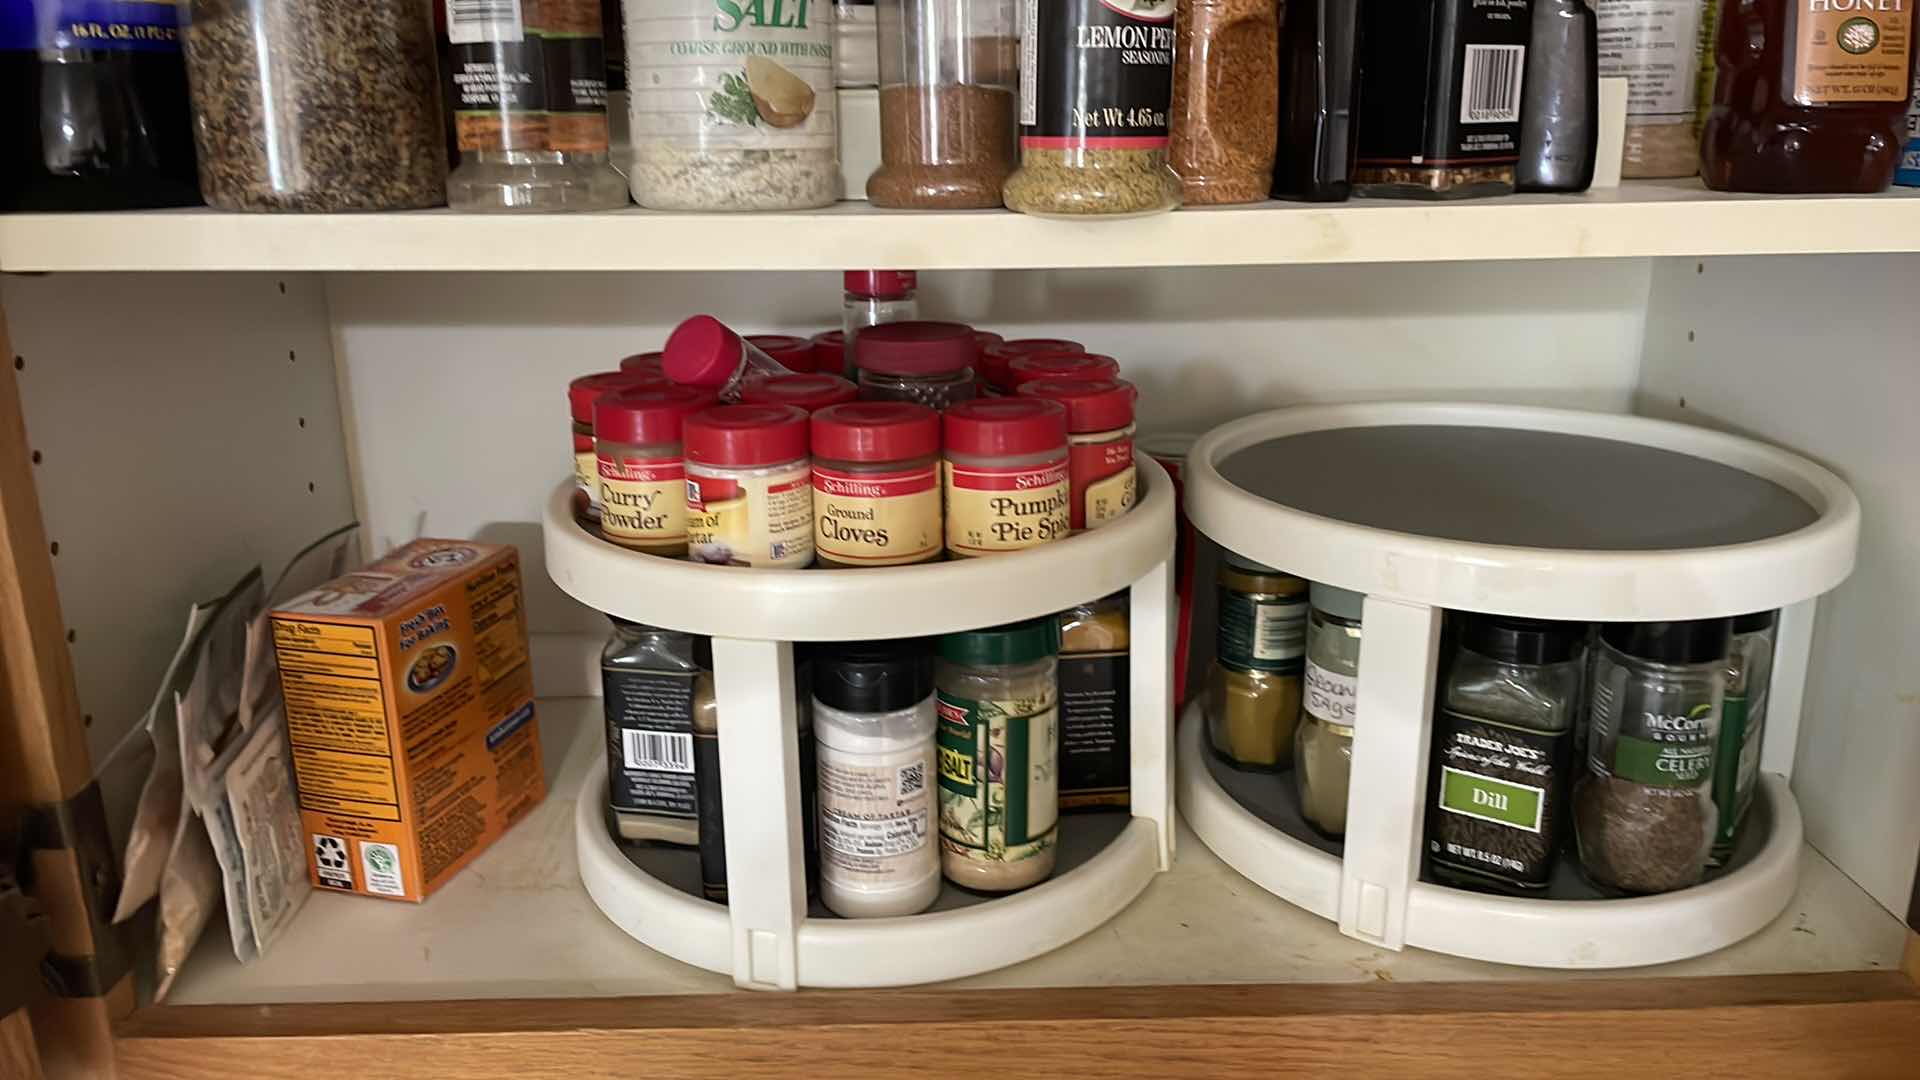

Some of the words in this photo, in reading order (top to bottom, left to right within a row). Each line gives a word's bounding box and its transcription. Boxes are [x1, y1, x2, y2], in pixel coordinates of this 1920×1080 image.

[1076, 26, 1148, 48] LEMON
[1073, 108, 1100, 128] Net
[1126, 108, 1152, 128] 4.65
[601, 481, 662, 512] Curry
[823, 479, 881, 497] Schilling
[601, 504, 668, 530] Powder
[827, 503, 874, 521] Ground
[820, 515, 889, 547] Cloves
[991, 521, 1033, 542] Pie
[1455, 732, 1504, 752] TRADER
[1472, 787, 1508, 812] Dill
